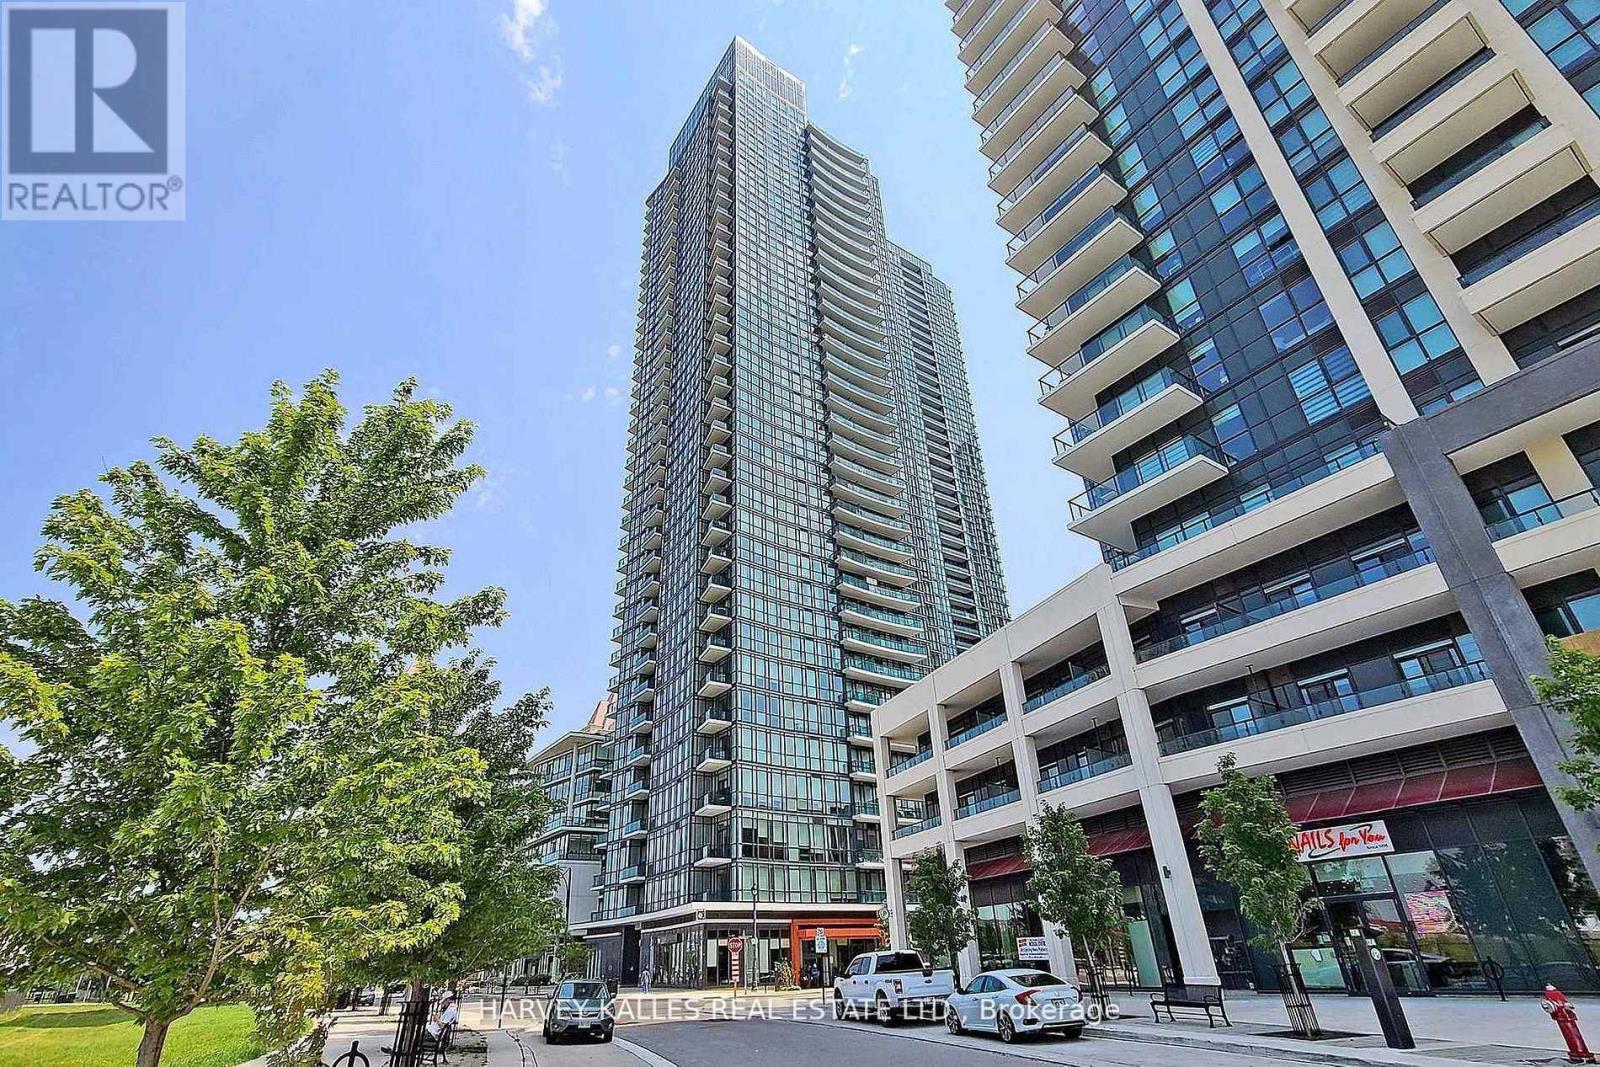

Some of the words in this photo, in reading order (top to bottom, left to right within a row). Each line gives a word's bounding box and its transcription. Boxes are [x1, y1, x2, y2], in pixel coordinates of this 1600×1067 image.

[1287, 828, 1335, 854] NAILS
[1339, 831, 1360, 852] for
[1359, 829, 1386, 845] You
